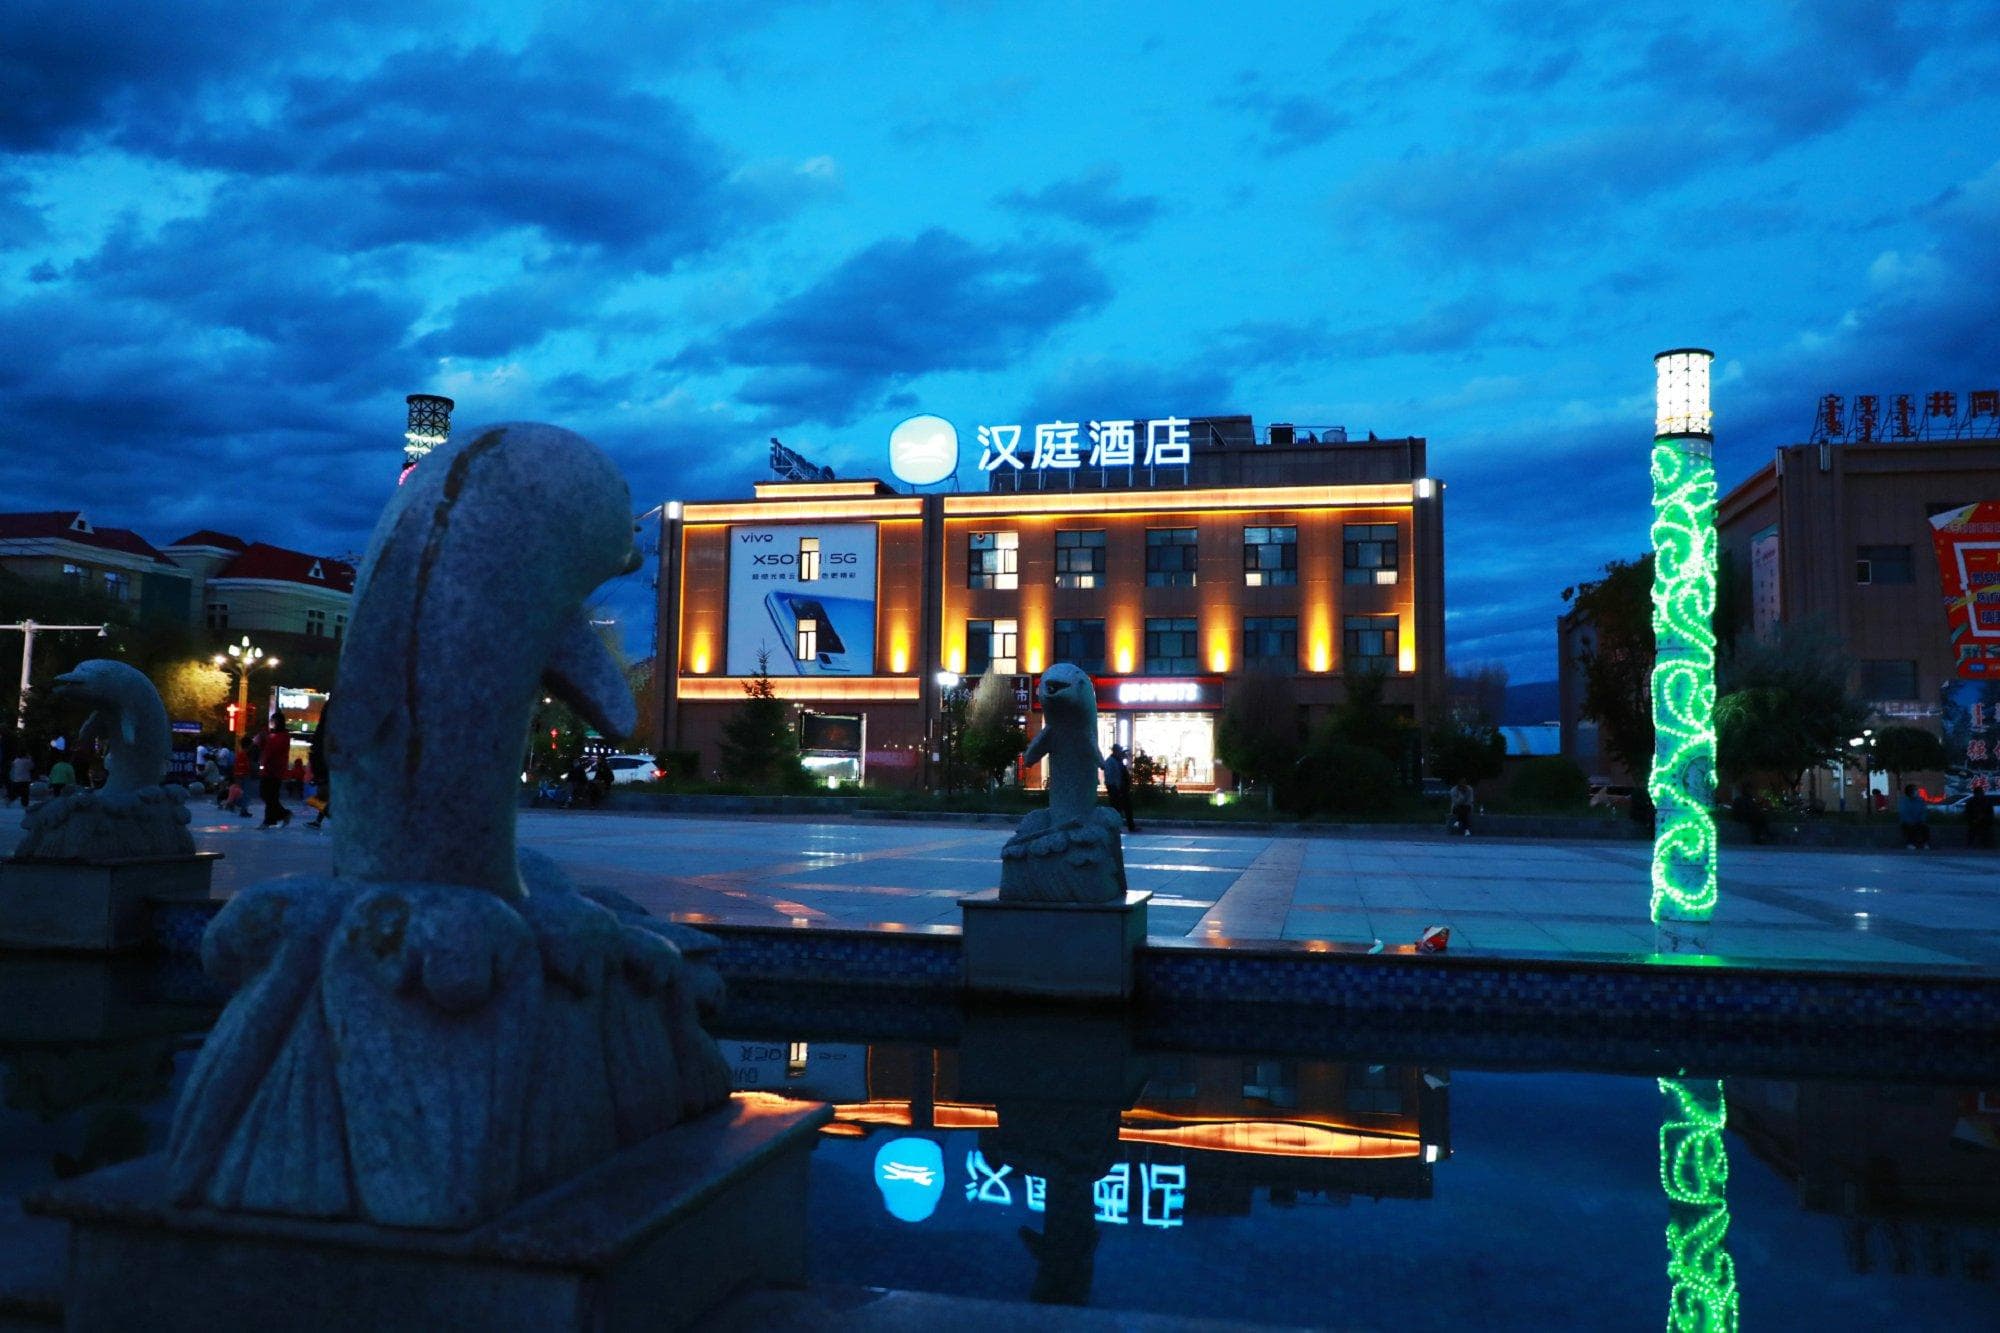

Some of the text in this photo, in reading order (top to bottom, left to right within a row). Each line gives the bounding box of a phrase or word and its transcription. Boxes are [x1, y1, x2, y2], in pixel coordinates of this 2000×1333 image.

[976, 415, 1191, 471] 汉庭酒店
[741, 532, 774, 543] vivo
[829, 552, 857, 564] 5G
